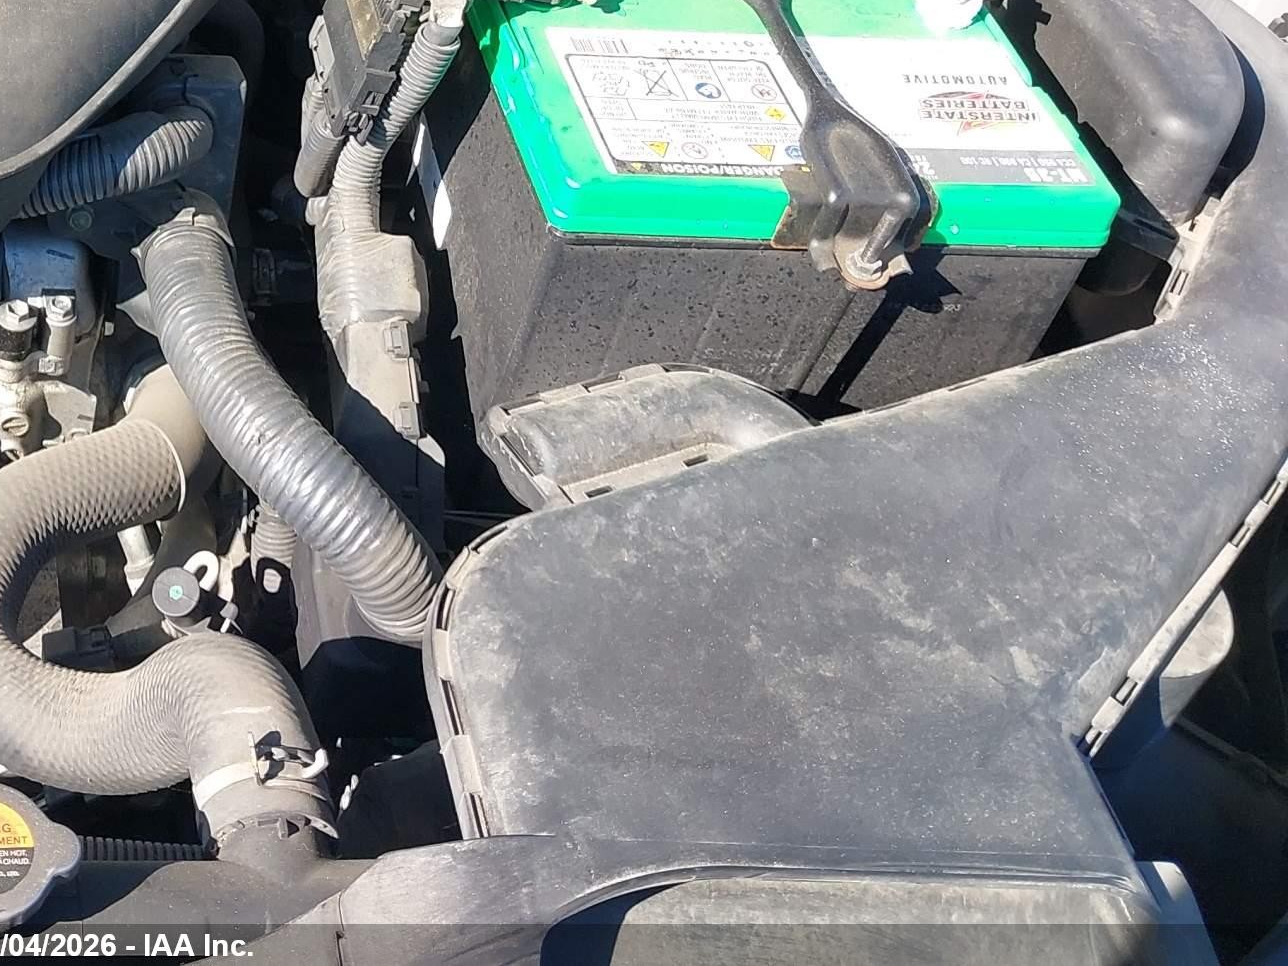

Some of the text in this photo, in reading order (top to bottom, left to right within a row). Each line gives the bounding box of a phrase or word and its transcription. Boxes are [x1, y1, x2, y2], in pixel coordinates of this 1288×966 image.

[903, 74, 1007, 85] AUTOMOTIVE
[922, 99, 1027, 109] BATTERIES
[922, 110, 1036, 121] INTERSTATE
